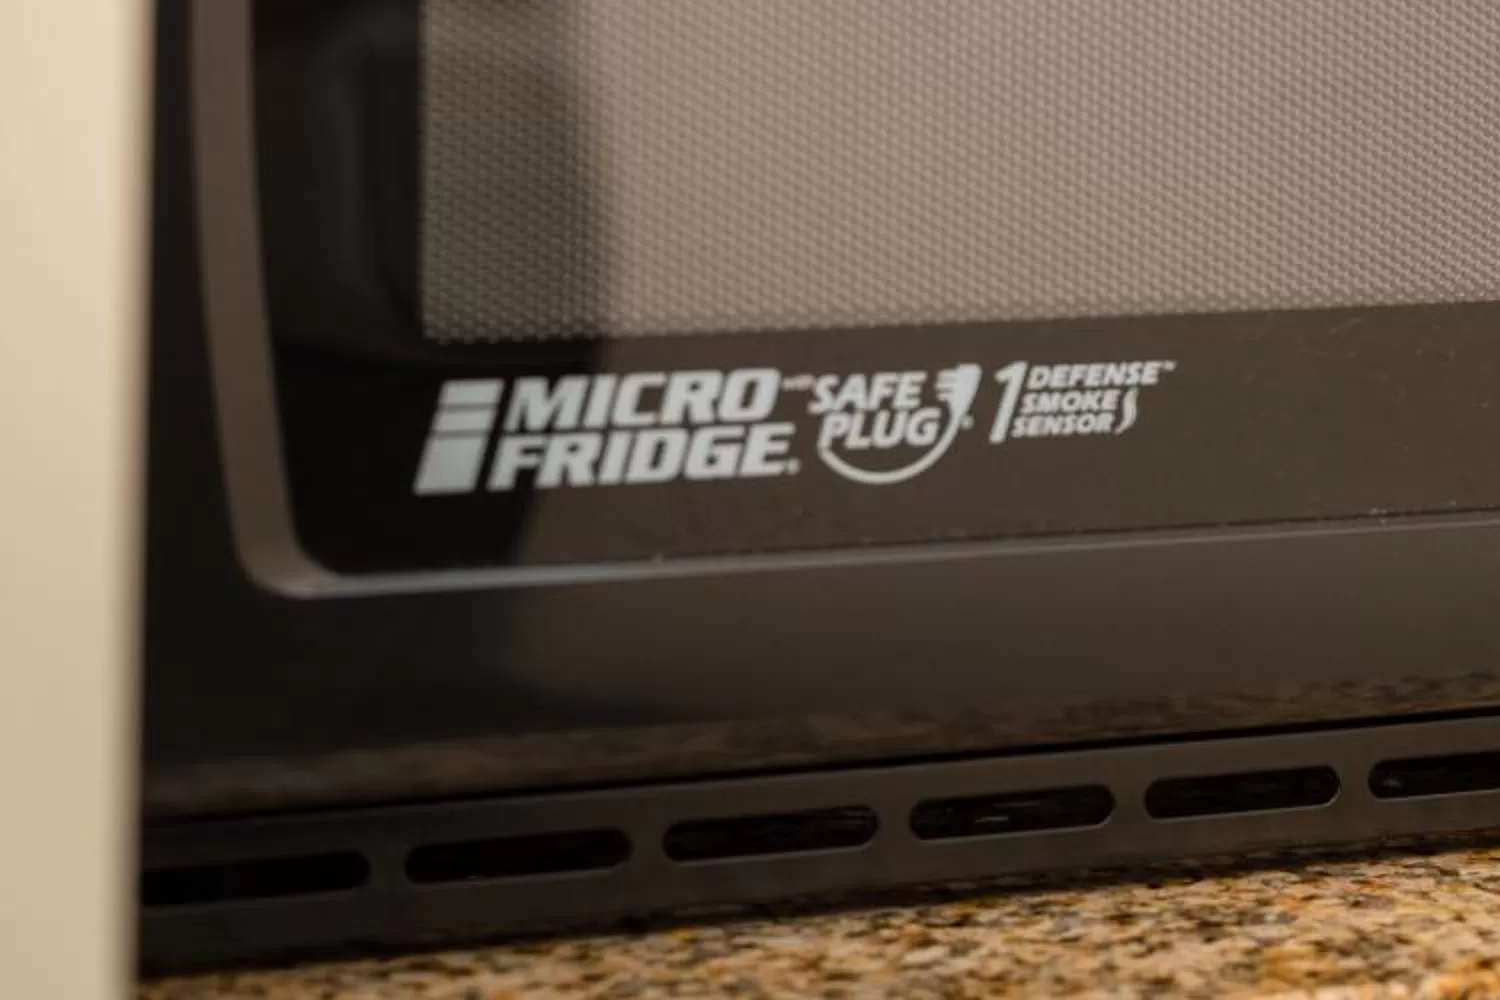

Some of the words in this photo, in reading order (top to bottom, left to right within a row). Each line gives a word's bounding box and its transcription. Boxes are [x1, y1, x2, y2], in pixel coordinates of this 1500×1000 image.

[503, 367, 781, 432] MICRO
[808, 371, 927, 414] SAFE
[989, 361, 1028, 444] 1
[1020, 388, 1121, 414] SMOKE
[817, 407, 942, 450] PLUG
[1011, 413, 1115, 438] SENSOR
